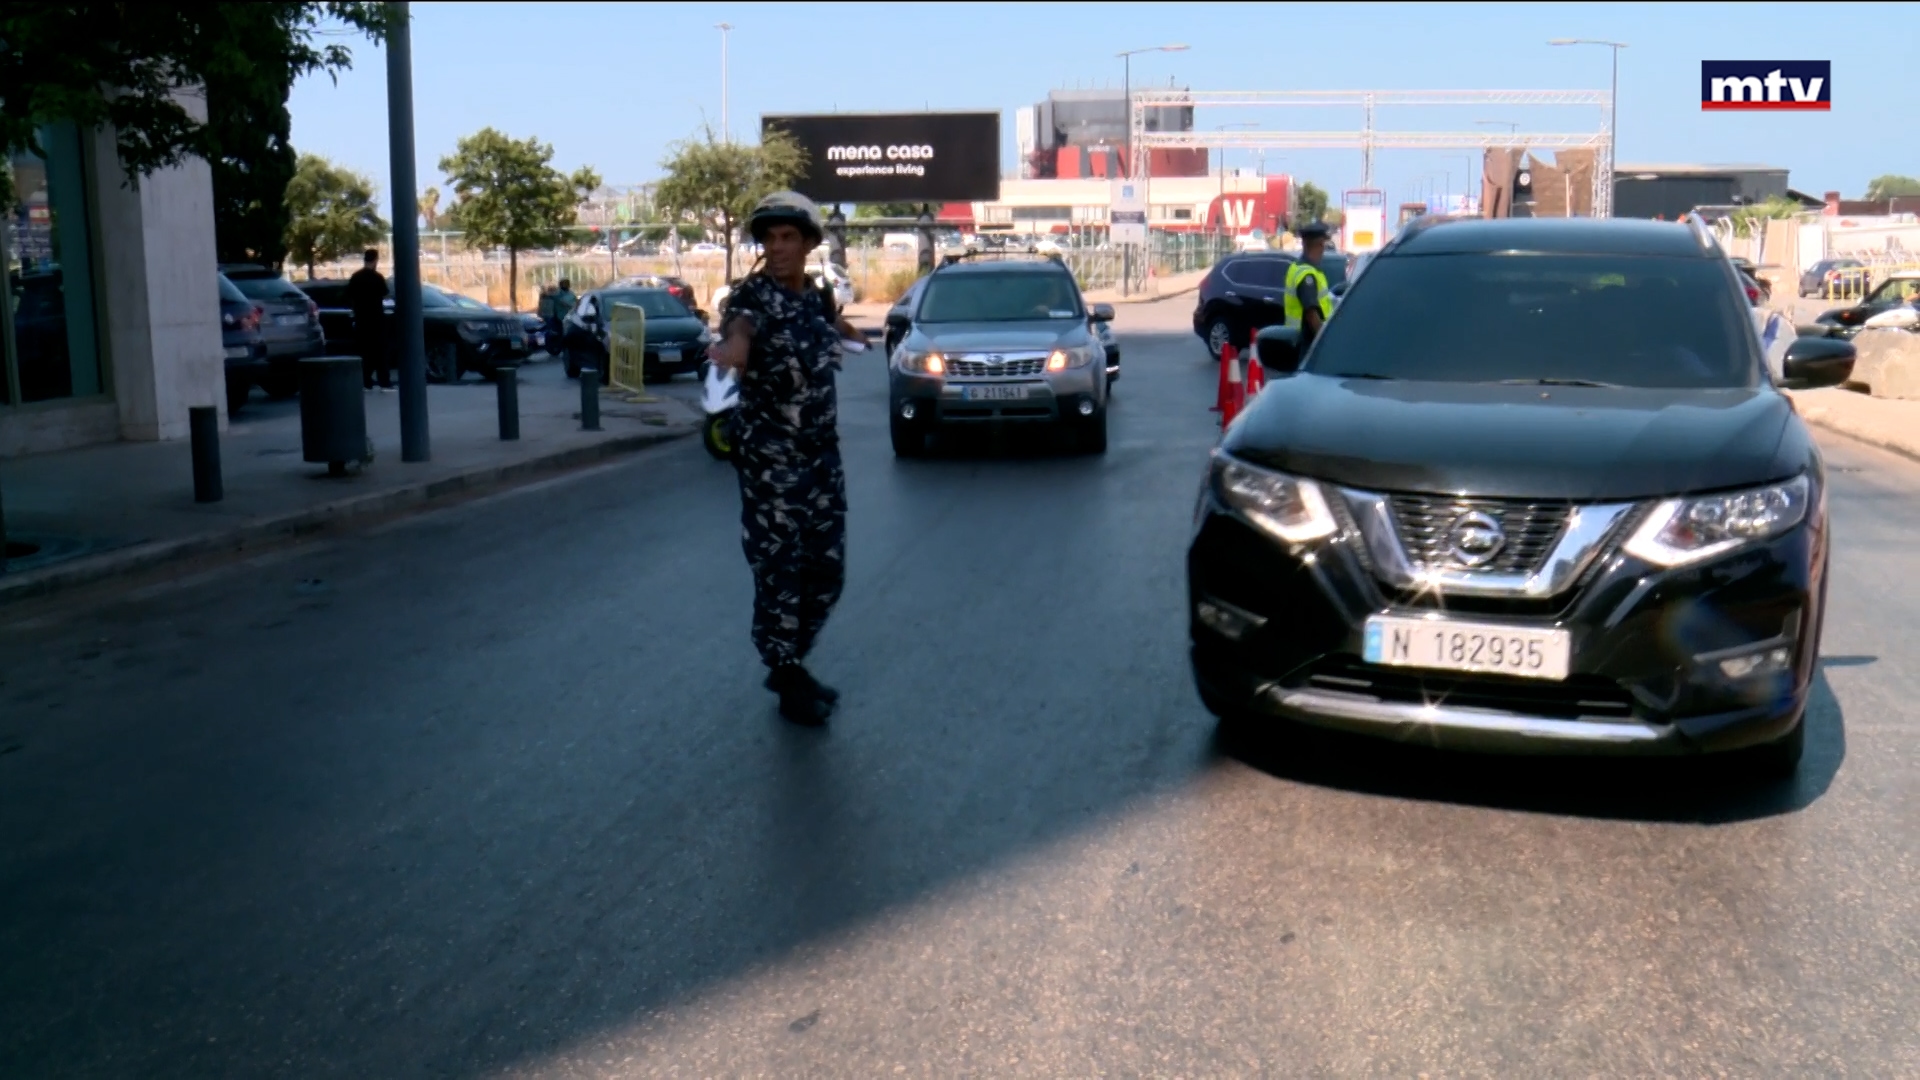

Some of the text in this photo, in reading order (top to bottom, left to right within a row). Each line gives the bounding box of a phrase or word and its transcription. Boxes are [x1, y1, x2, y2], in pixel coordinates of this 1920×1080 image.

[827, 144, 934, 160] mena casa
[836, 163, 925, 177] experience living
[1222, 199, 1255, 227] W
[1392, 628, 1544, 669] N 182935
